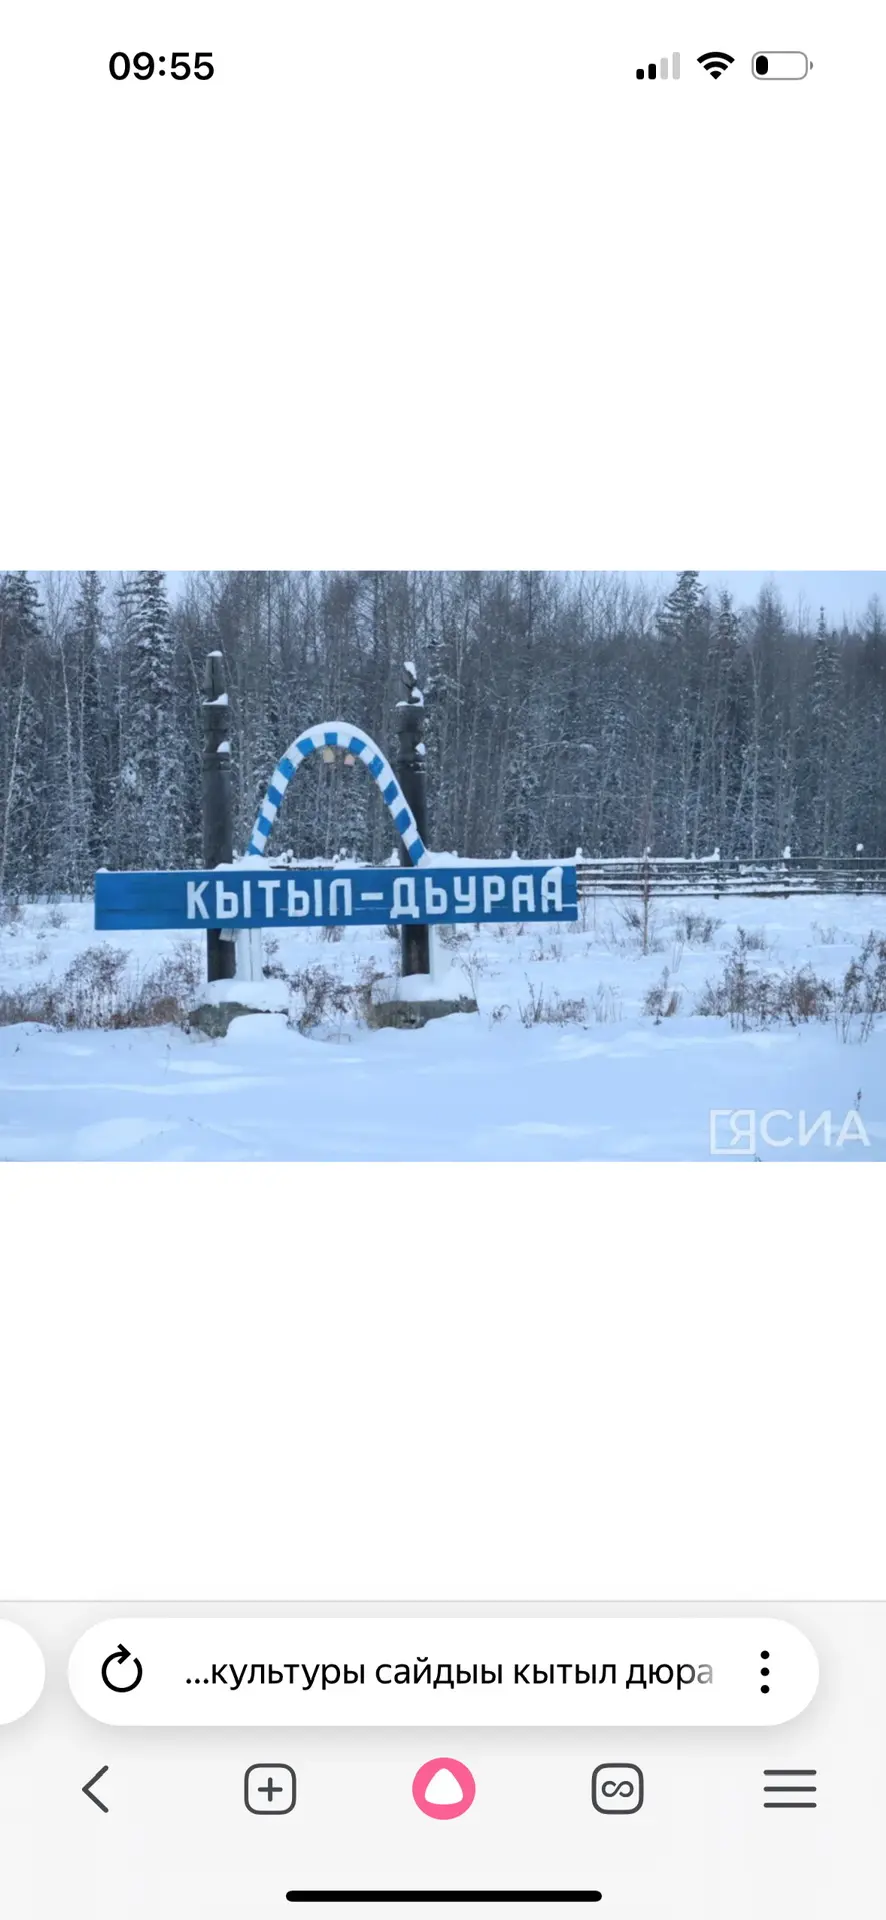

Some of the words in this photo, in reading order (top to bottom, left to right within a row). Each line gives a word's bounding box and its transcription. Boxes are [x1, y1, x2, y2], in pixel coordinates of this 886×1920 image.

[108, 51, 215, 81] 09:55
[186, 873, 564, 920] КЫТЫЛ-ДЬУРАА
[375, 1656, 503, 1690] сайдыы
[513, 1663, 617, 1685] кытыл
[625, 1663, 713, 1691] дюра
